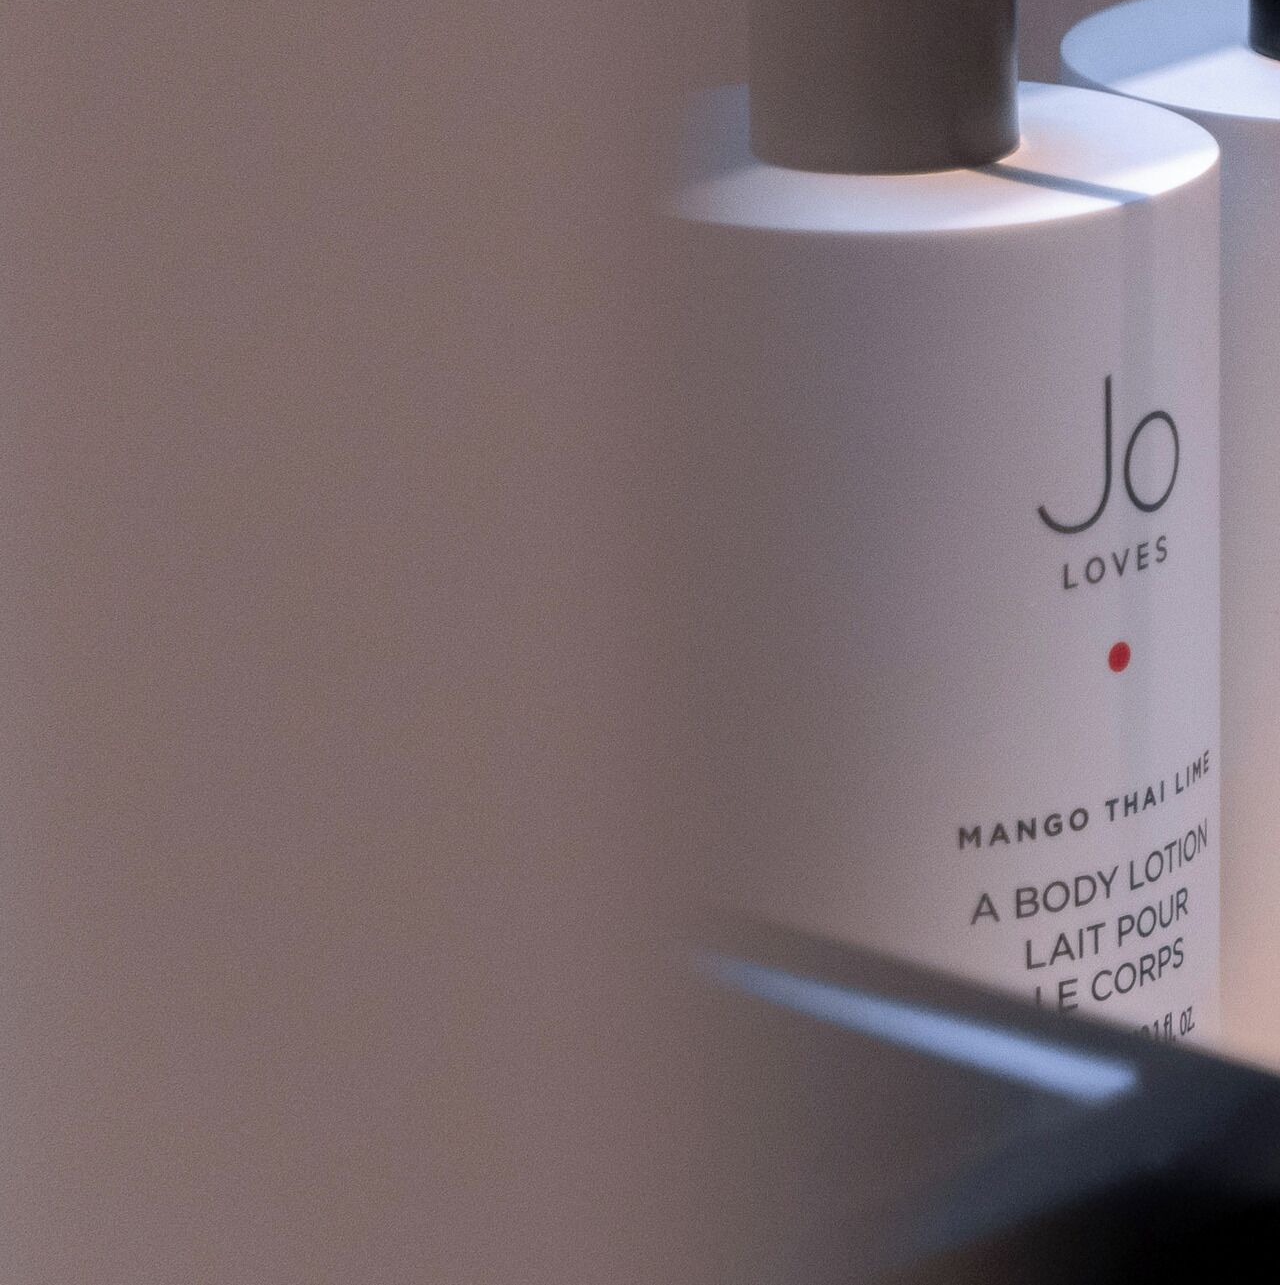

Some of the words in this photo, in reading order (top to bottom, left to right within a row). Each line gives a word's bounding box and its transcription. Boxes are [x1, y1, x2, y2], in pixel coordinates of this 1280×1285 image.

[1037, 372, 1180, 534] Jo
[1062, 534, 1168, 591] LOVES
[957, 807, 1090, 850] MANGO
[1104, 779, 1166, 823] THAI
[1175, 748, 1210, 797] LIME
[970, 891, 1001, 926] A
[1015, 864, 1119, 920] BODY
[1129, 817, 1208, 892] LOTION
[1025, 922, 1107, 971] LAIT
[1118, 886, 1189, 948] POUR
[1091, 935, 1185, 1003] CORPS
